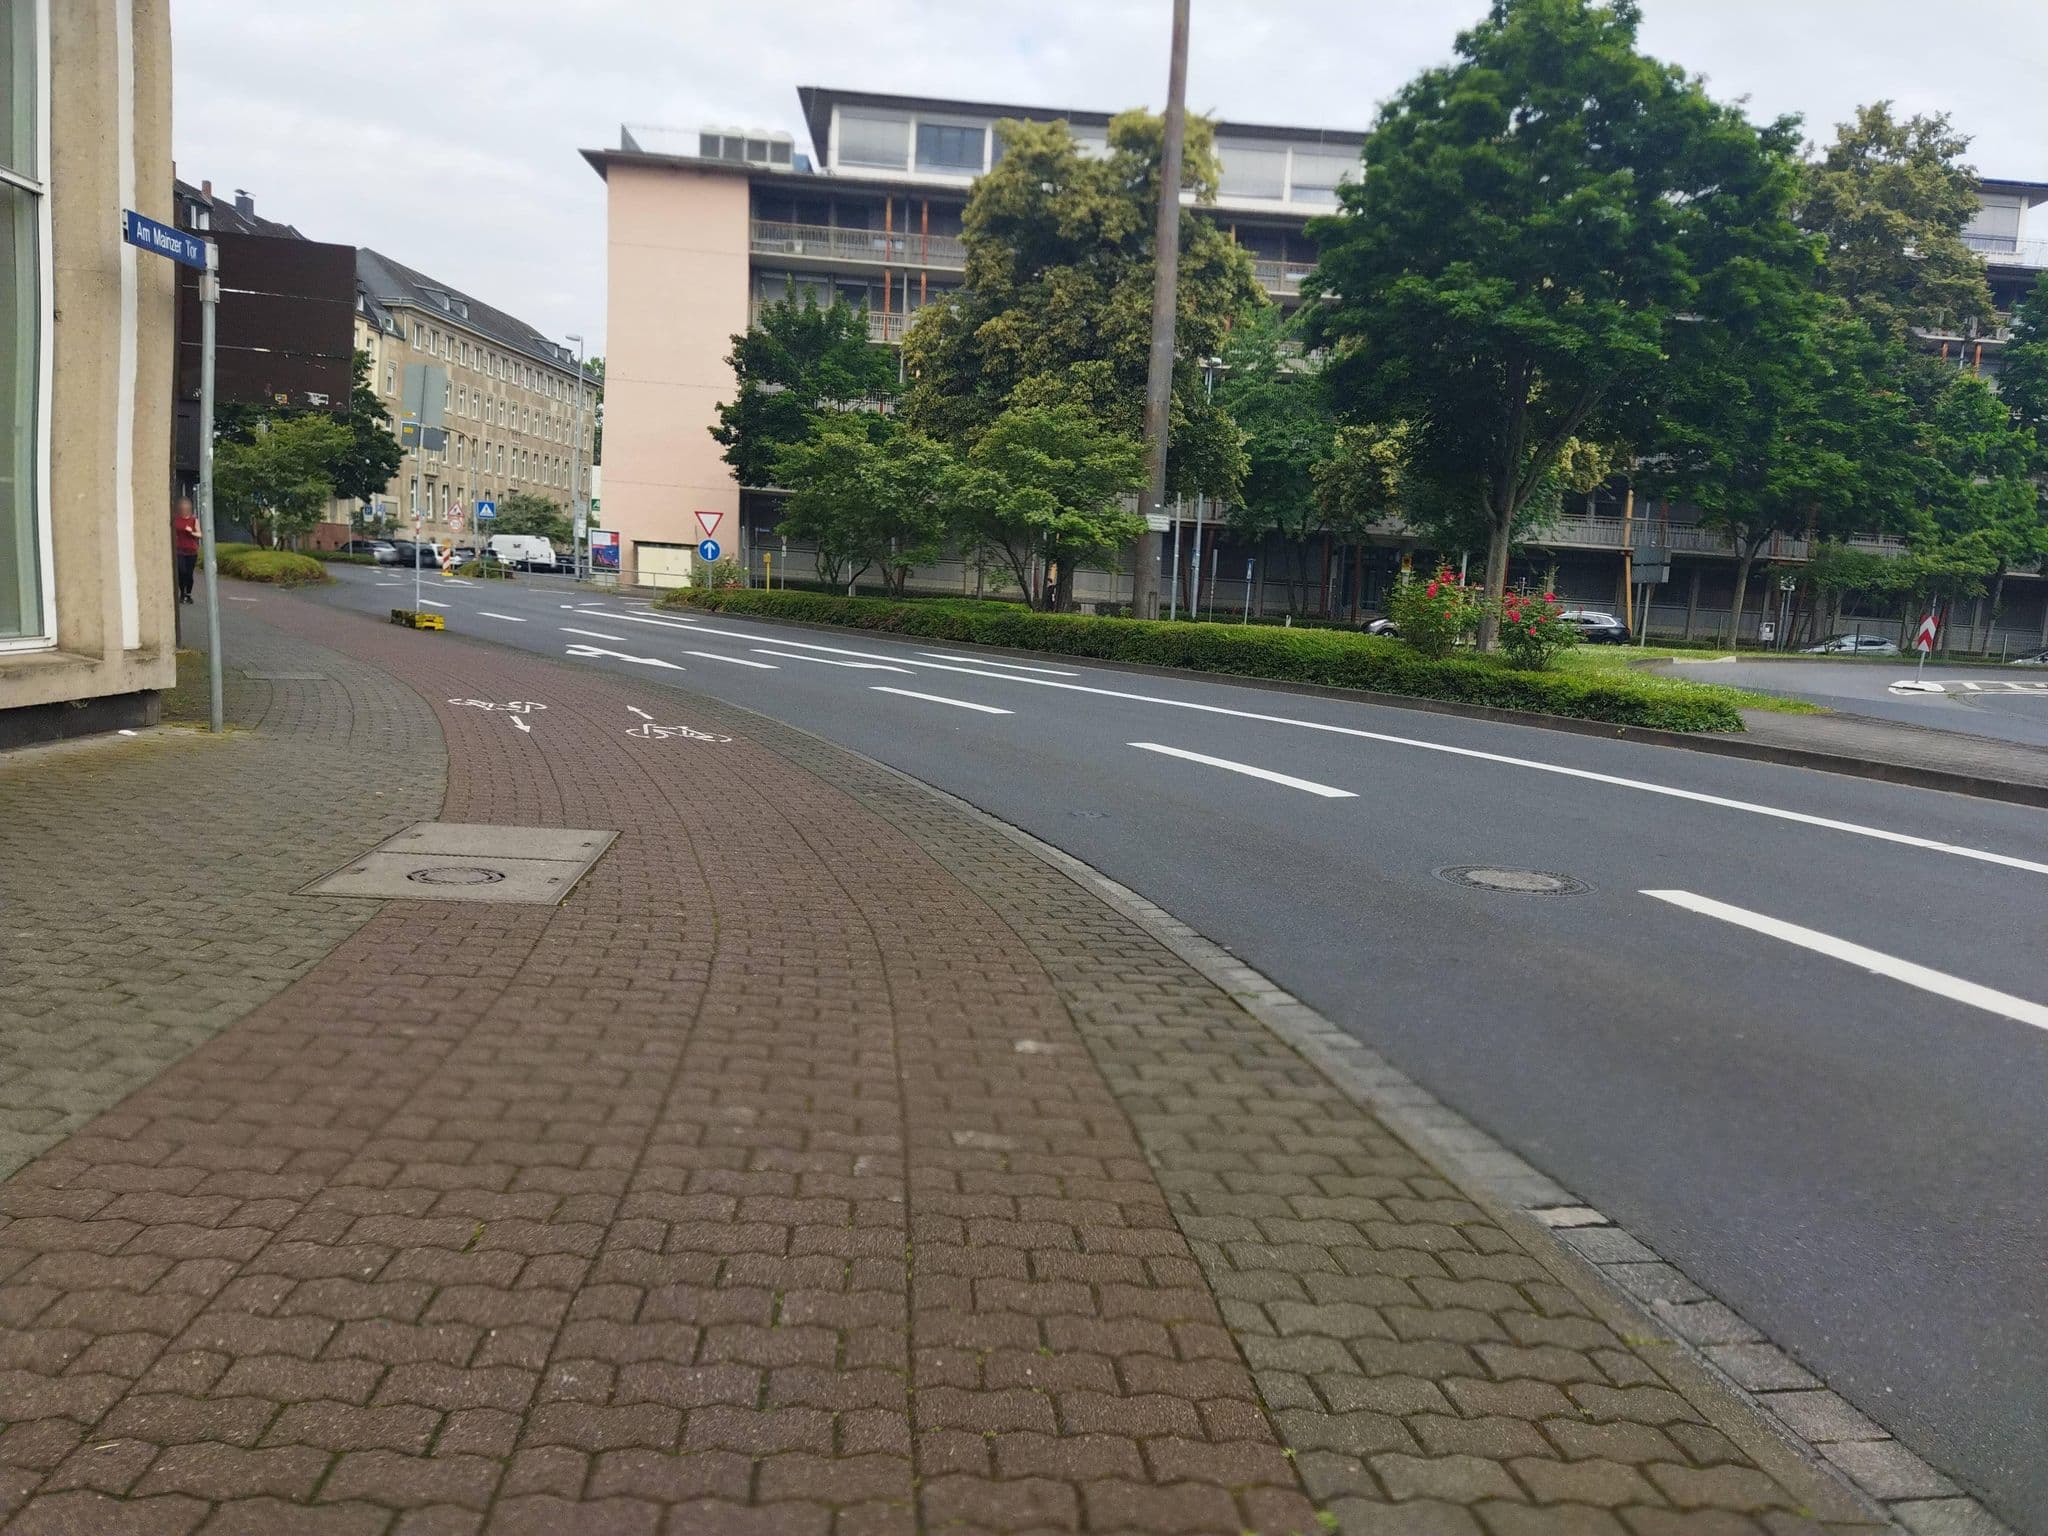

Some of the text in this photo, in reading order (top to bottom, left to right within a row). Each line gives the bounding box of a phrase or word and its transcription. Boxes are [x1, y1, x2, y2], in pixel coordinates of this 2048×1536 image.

[137, 221, 198, 260] Am Mainzer Tor
